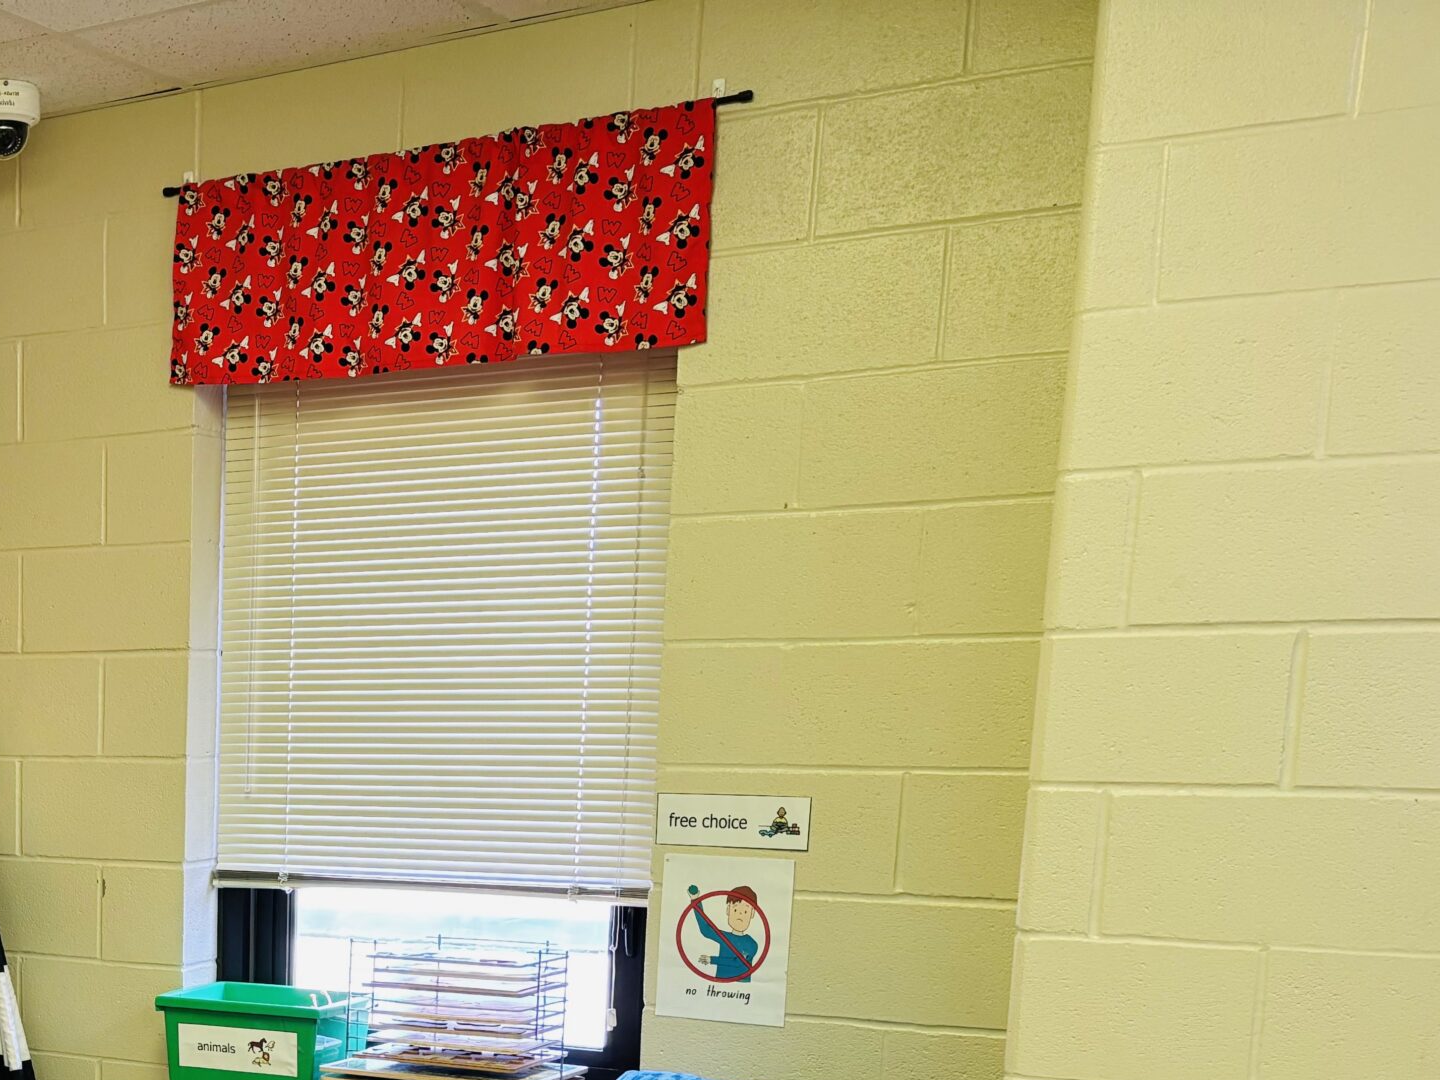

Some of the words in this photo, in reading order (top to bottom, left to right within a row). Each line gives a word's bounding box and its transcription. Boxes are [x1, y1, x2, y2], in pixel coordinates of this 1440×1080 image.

[669, 812, 697, 828] free
[702, 813, 748, 830] choice
[685, 987, 697, 996] no
[707, 985, 751, 1005] throwing
[197, 1039, 236, 1055] animals
